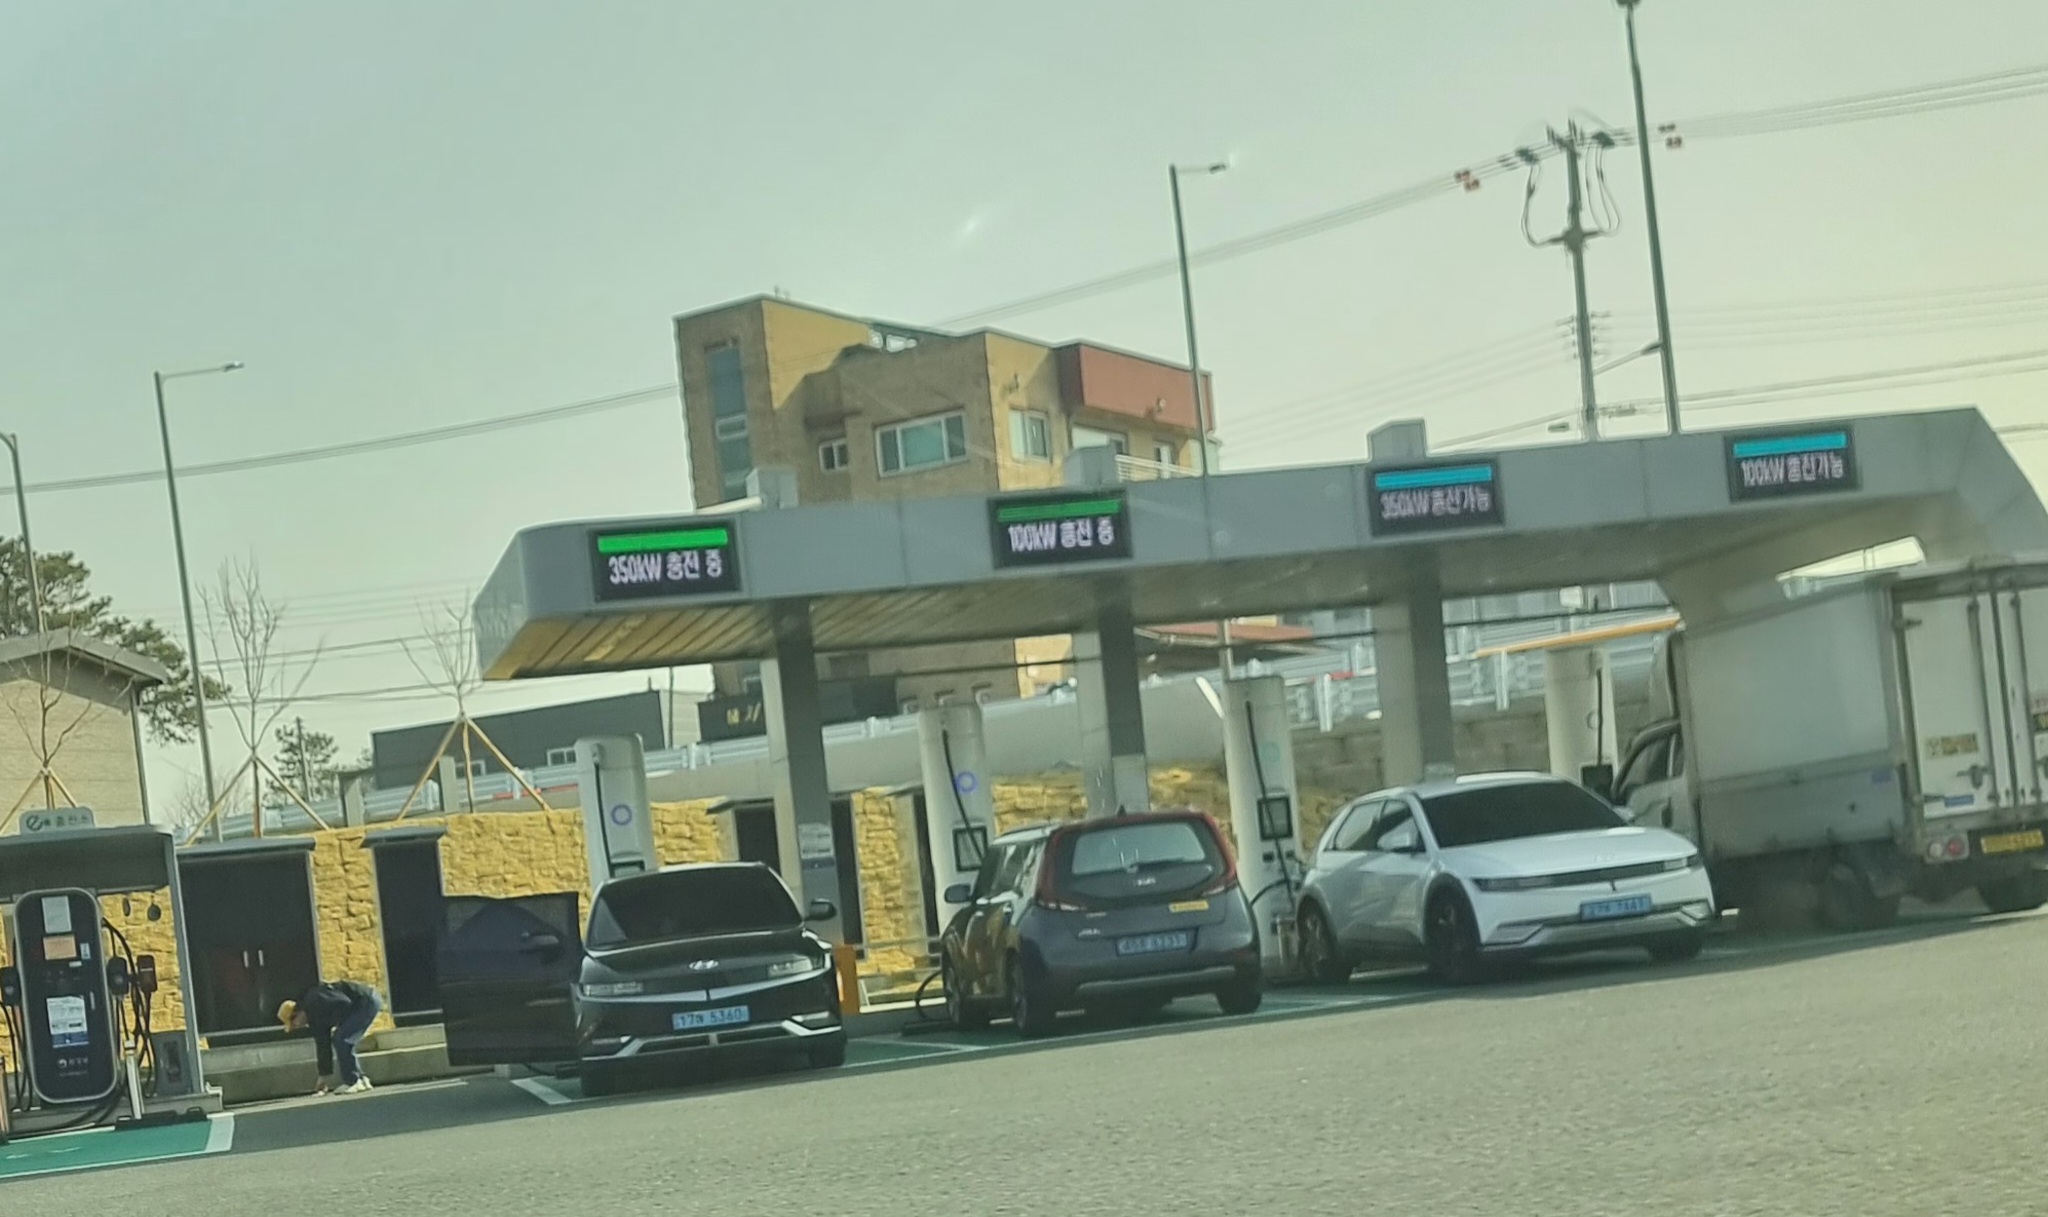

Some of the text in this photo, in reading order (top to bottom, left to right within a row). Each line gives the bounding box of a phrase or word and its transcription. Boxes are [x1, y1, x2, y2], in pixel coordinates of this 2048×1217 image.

[1741, 457, 1785, 487] 100kW
[1008, 515, 1114, 552] 100kW 충전 중
[608, 549, 722, 584] 350kW 충전 중
